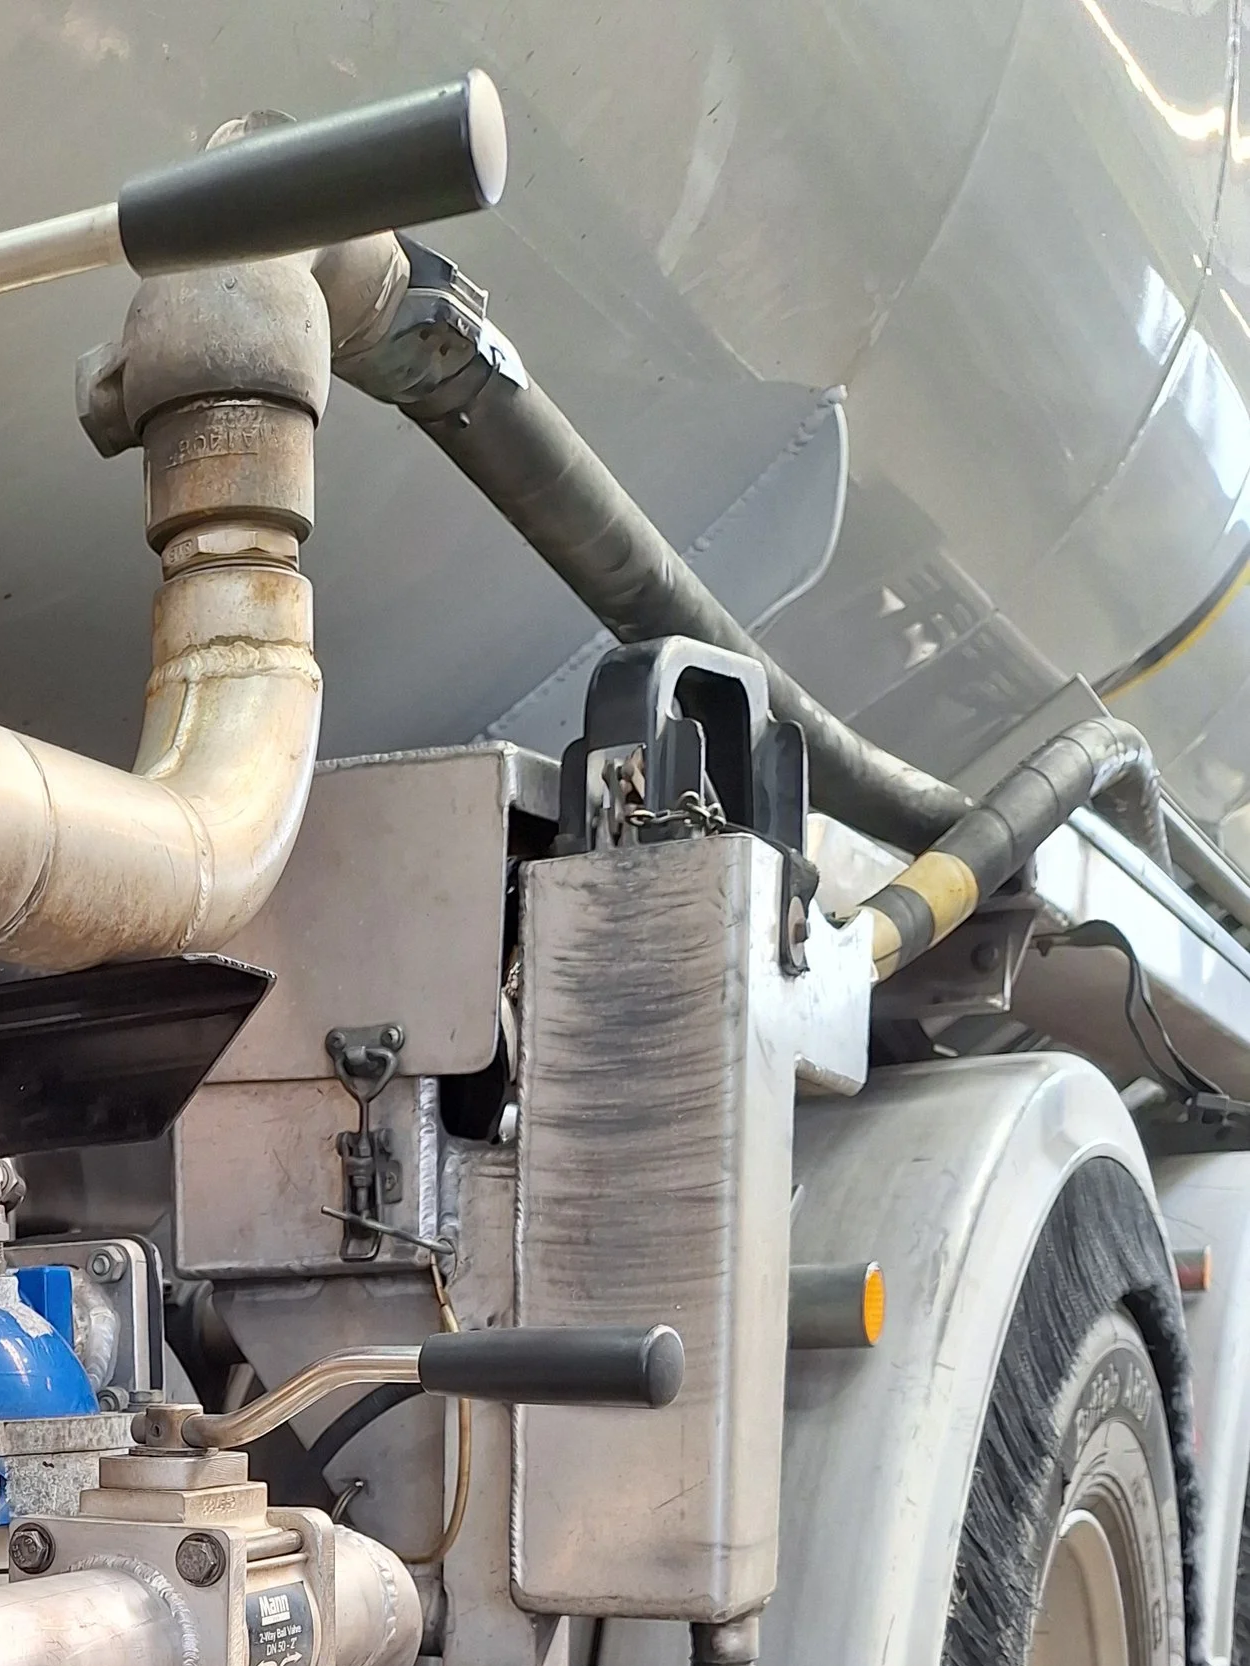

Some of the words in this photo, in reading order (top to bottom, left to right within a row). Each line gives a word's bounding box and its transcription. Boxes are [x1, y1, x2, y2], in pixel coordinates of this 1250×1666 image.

[258, 1594, 290, 1617] Mann
[276, 1627, 287, 1638] Ball
[287, 1624, 302, 1635] Valve
[266, 1643, 277, 1656] DN
[278, 1640, 286, 1653] 50
